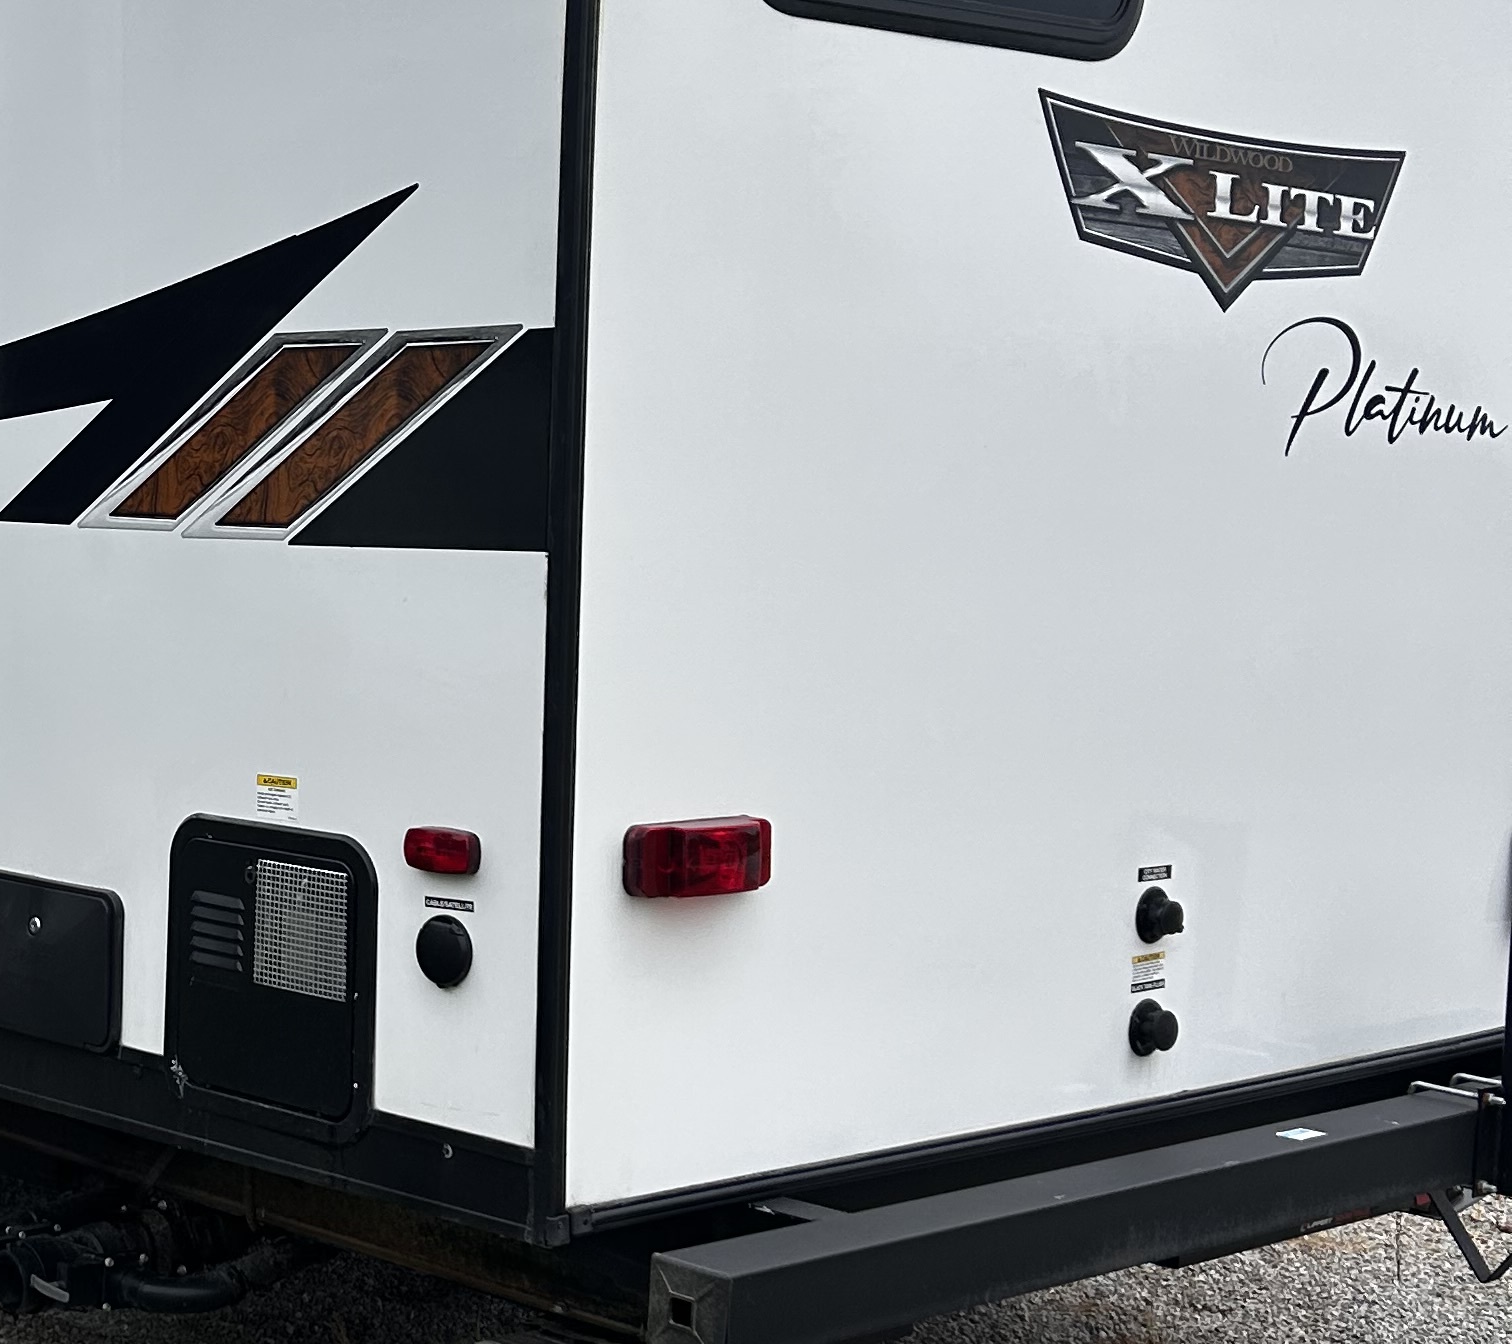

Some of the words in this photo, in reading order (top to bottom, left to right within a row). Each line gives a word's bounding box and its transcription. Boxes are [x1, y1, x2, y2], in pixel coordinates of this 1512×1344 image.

[1072, 140, 1194, 220] X
[1207, 170, 1375, 239] LITE
[1168, 135, 1293, 174] WILDWOOD
[1261, 316, 1508, 456] Platinum
